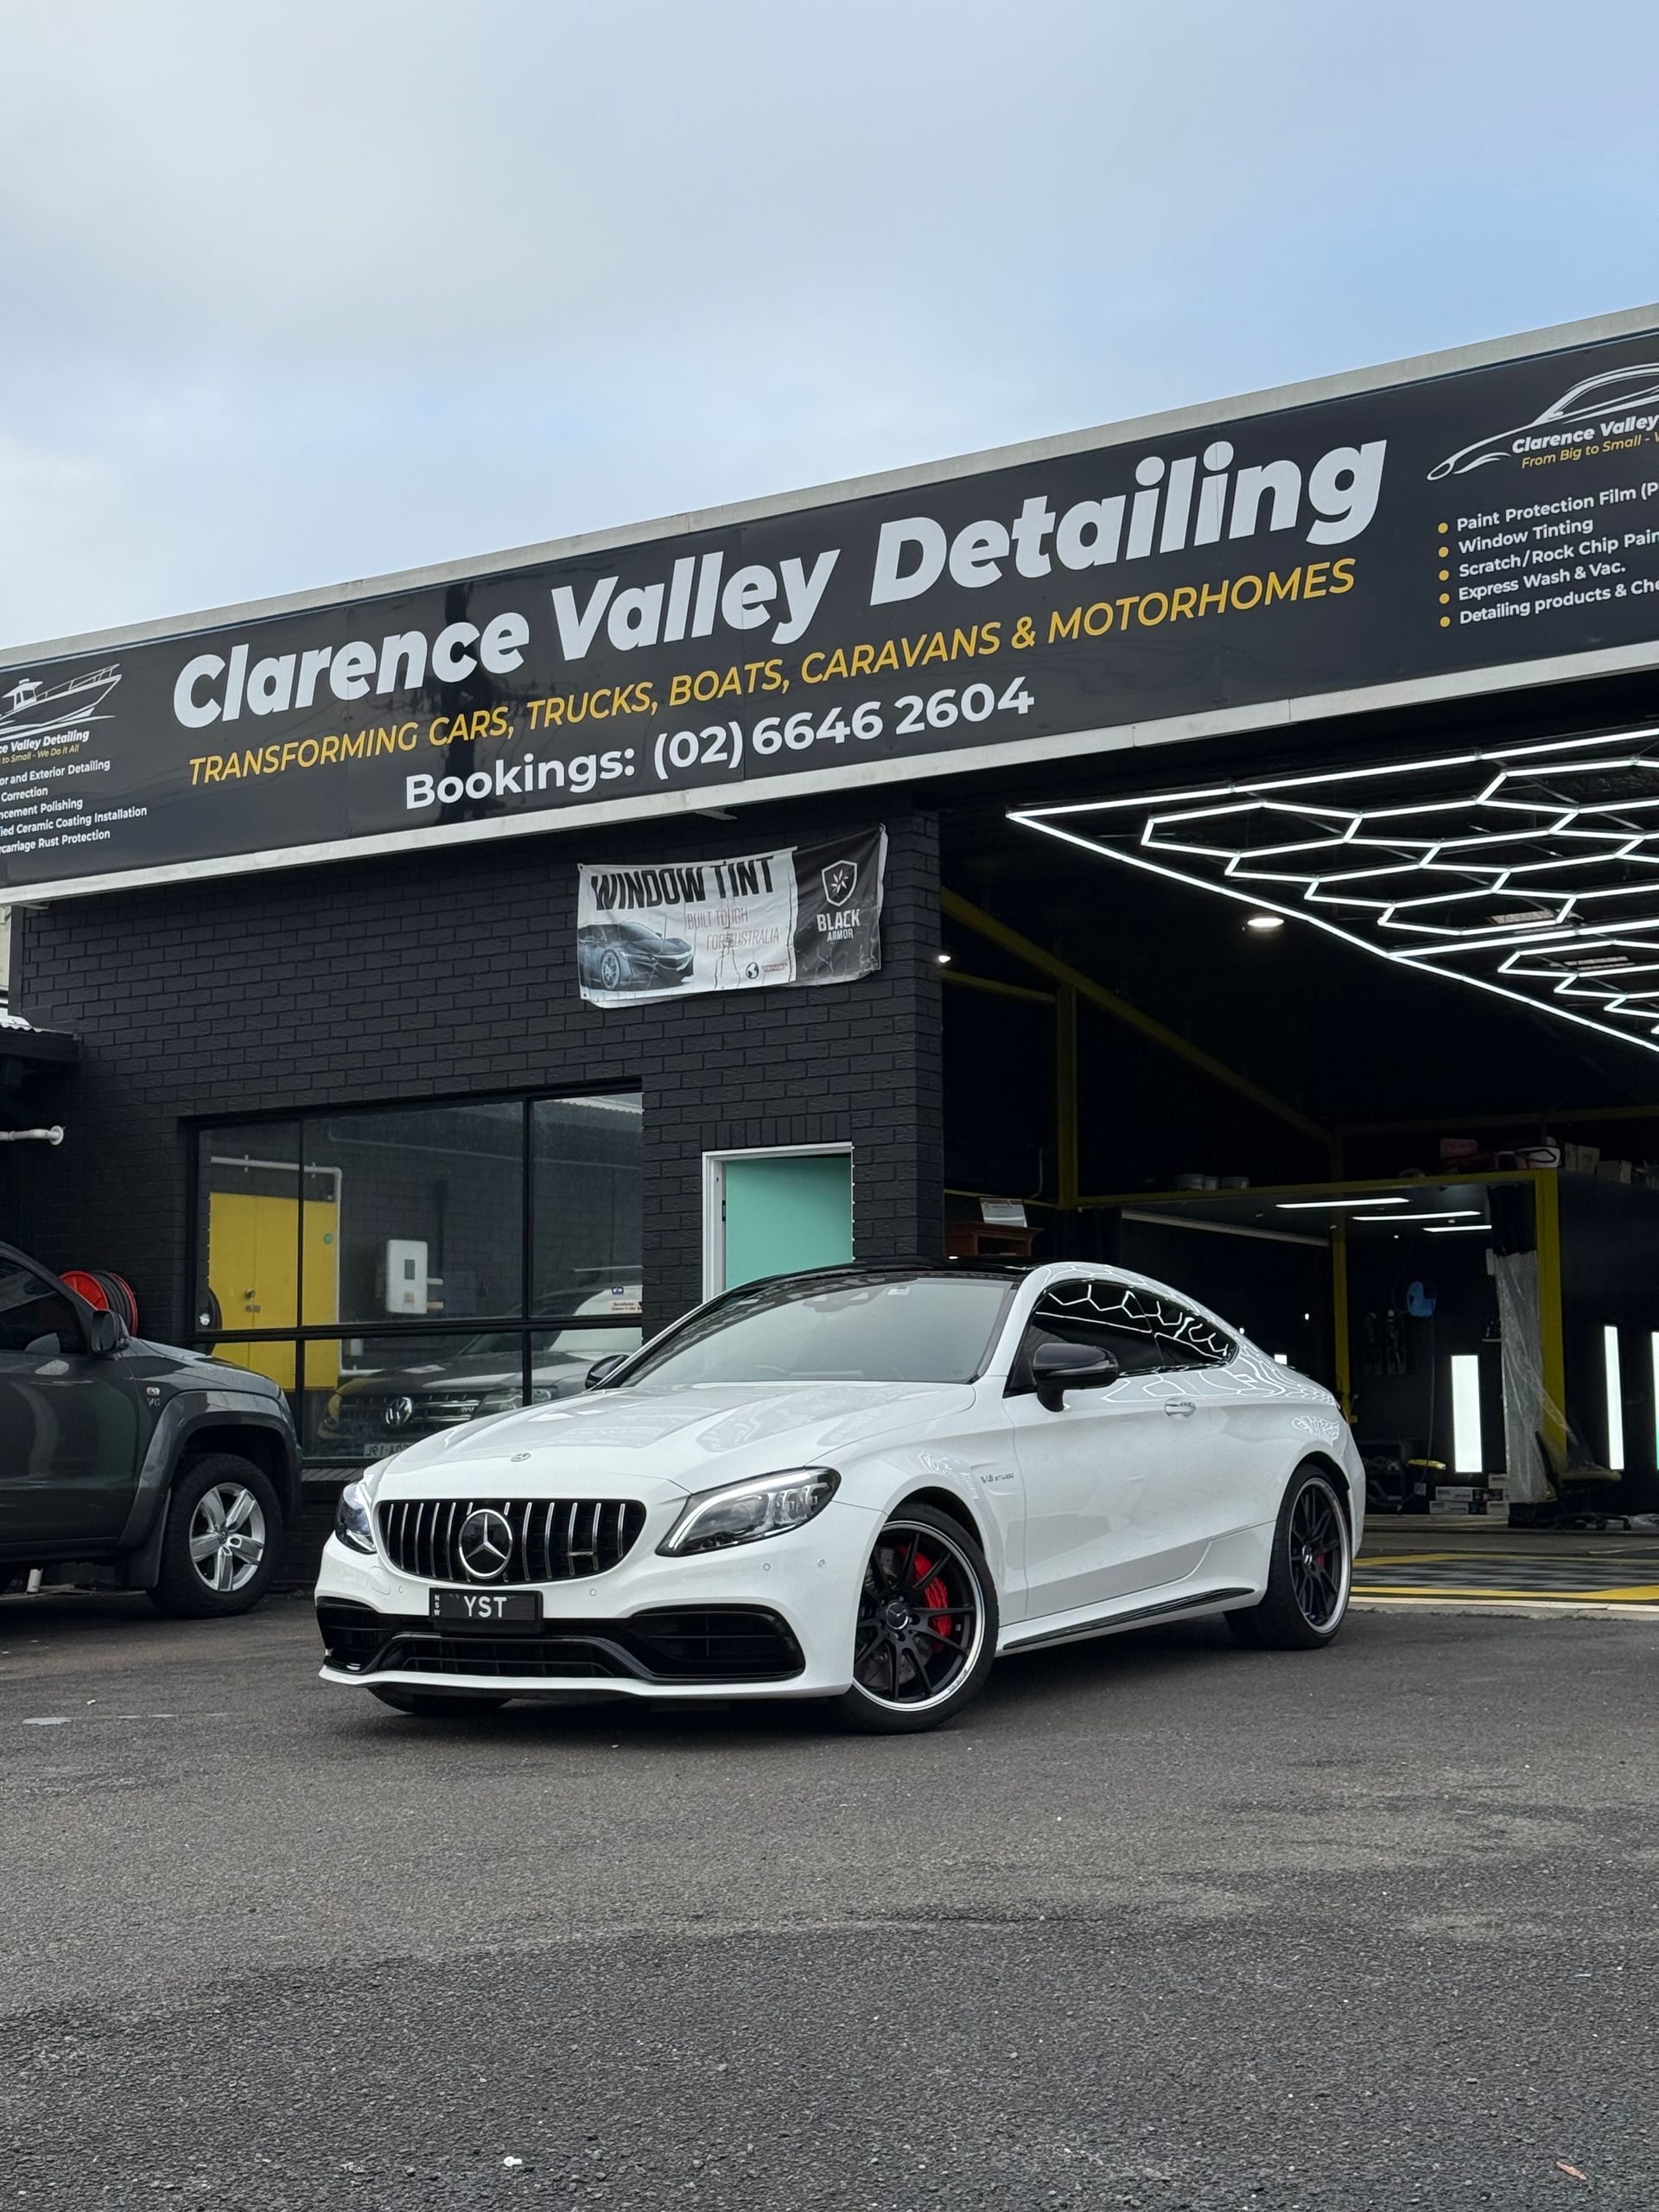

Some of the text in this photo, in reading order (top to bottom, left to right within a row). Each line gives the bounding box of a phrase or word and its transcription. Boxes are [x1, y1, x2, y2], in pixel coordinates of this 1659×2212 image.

[1511, 415, 1659, 454] Clarence Valley
[1521, 454, 1556, 469] From
[1560, 447, 1582, 461] Big
[1586, 445, 1599, 455] to
[1602, 434, 1642, 452] Small
[1457, 512, 1500, 531] Paint
[1505, 496, 1595, 523] Protection
[1599, 488, 1637, 506] Film
[1459, 519, 1593, 554] Window Tinting
[1459, 544, 1575, 577] Scratch/Rock
[1579, 537, 1619, 554] Chip
[173, 438, 1388, 728] Clarence Valley Detailing
[1459, 562, 1626, 601] Express Wash & Vac.
[1459, 600, 1530, 624] Detailing
[1534, 588, 1611, 614] products
[1614, 583, 1627, 597] &
[188, 558, 1356, 785] TRANSFORMING CARS, TRUCKS, BOATS, CARAVANS & MOTORHOMES
[10, 738, 41, 753] Valley
[43, 729, 90, 747] Detailing
[10, 751, 32, 763] Small
[37, 749, 50, 759] We
[50, 747, 61, 757] Do
[69, 744, 79, 753] All
[405, 677, 1035, 810] Bookings: (02) 6646 2604
[10, 771, 28, 785] and
[29, 766, 65, 781] Exterior
[67, 760, 111, 775] Detailing
[1, 786, 48, 802] Correction
[40, 798, 83, 814] Polishing
[16, 819, 54, 834] Ceramic
[55, 814, 92, 829] Coating
[94, 805, 148, 823] Installation
[38, 836, 60, 849] Rust
[61, 830, 111, 845] Protection
[591, 855, 774, 911] WINDOW TINT
[687, 906, 748, 930] BUILT TOUGH
[817, 908, 861, 932] BLACK
[827, 928, 854, 942] ARMOR
[463, 1595, 507, 1618] YST
